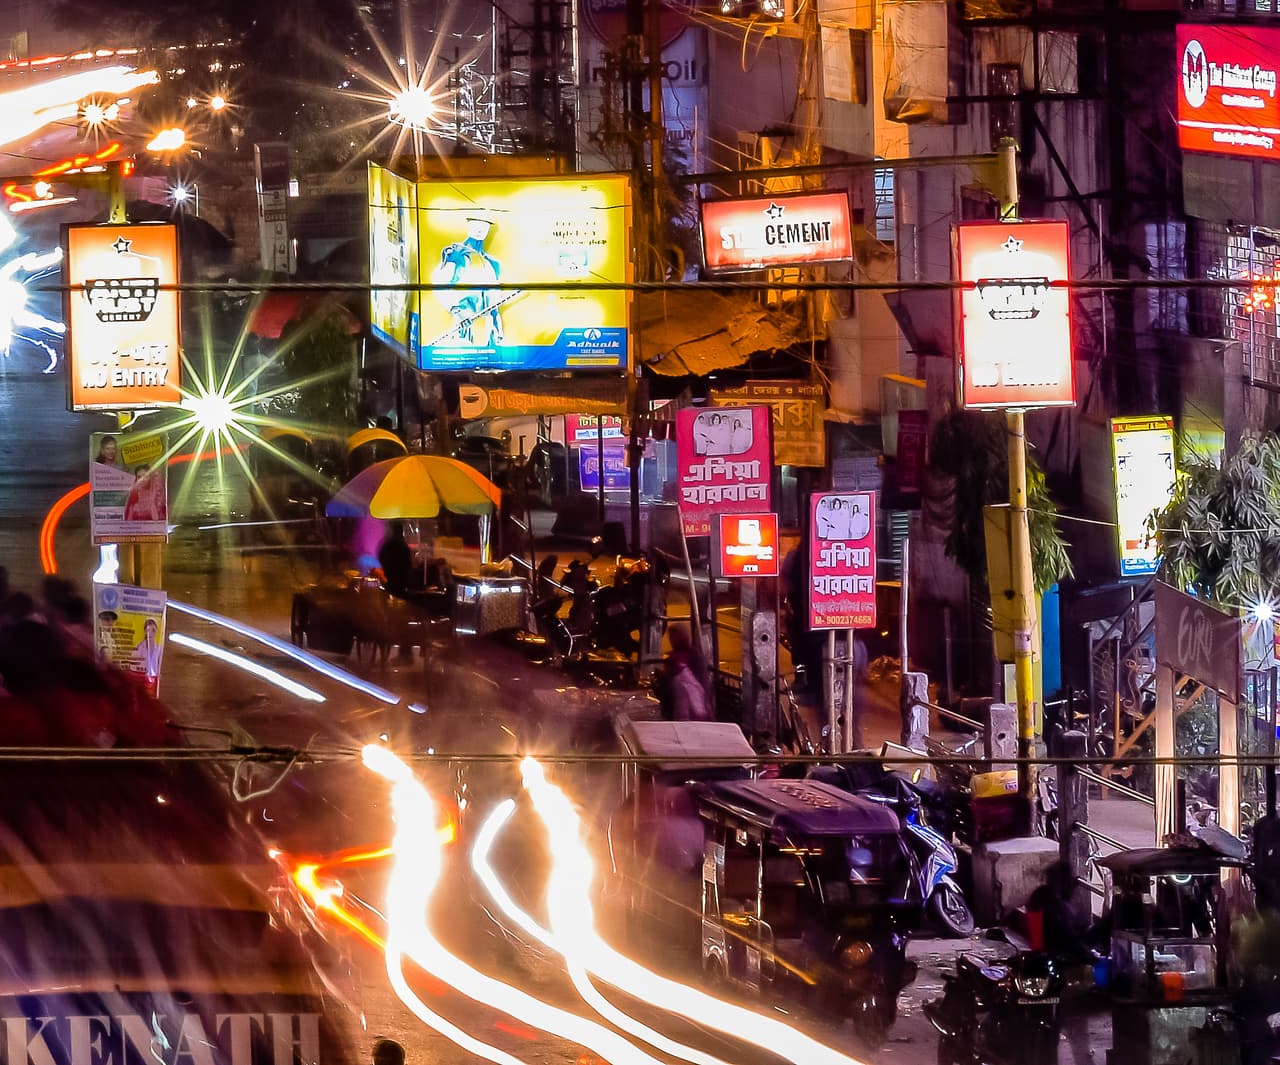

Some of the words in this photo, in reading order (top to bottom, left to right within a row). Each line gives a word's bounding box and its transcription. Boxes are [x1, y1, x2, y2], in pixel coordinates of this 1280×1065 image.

[584, 60, 697, 82] InOil
[765, 221, 832, 246] CEMENT
[566, 340, 620, 348] Adhunik
[81, 367, 108, 389] NO
[111, 366, 168, 388] ENTRY
[683, 457, 761, 482] এশিয়া
[681, 483, 769, 505] হারবাল
[816, 542, 871, 569] এশিয়া
[812, 574, 874, 596] হারবাল
